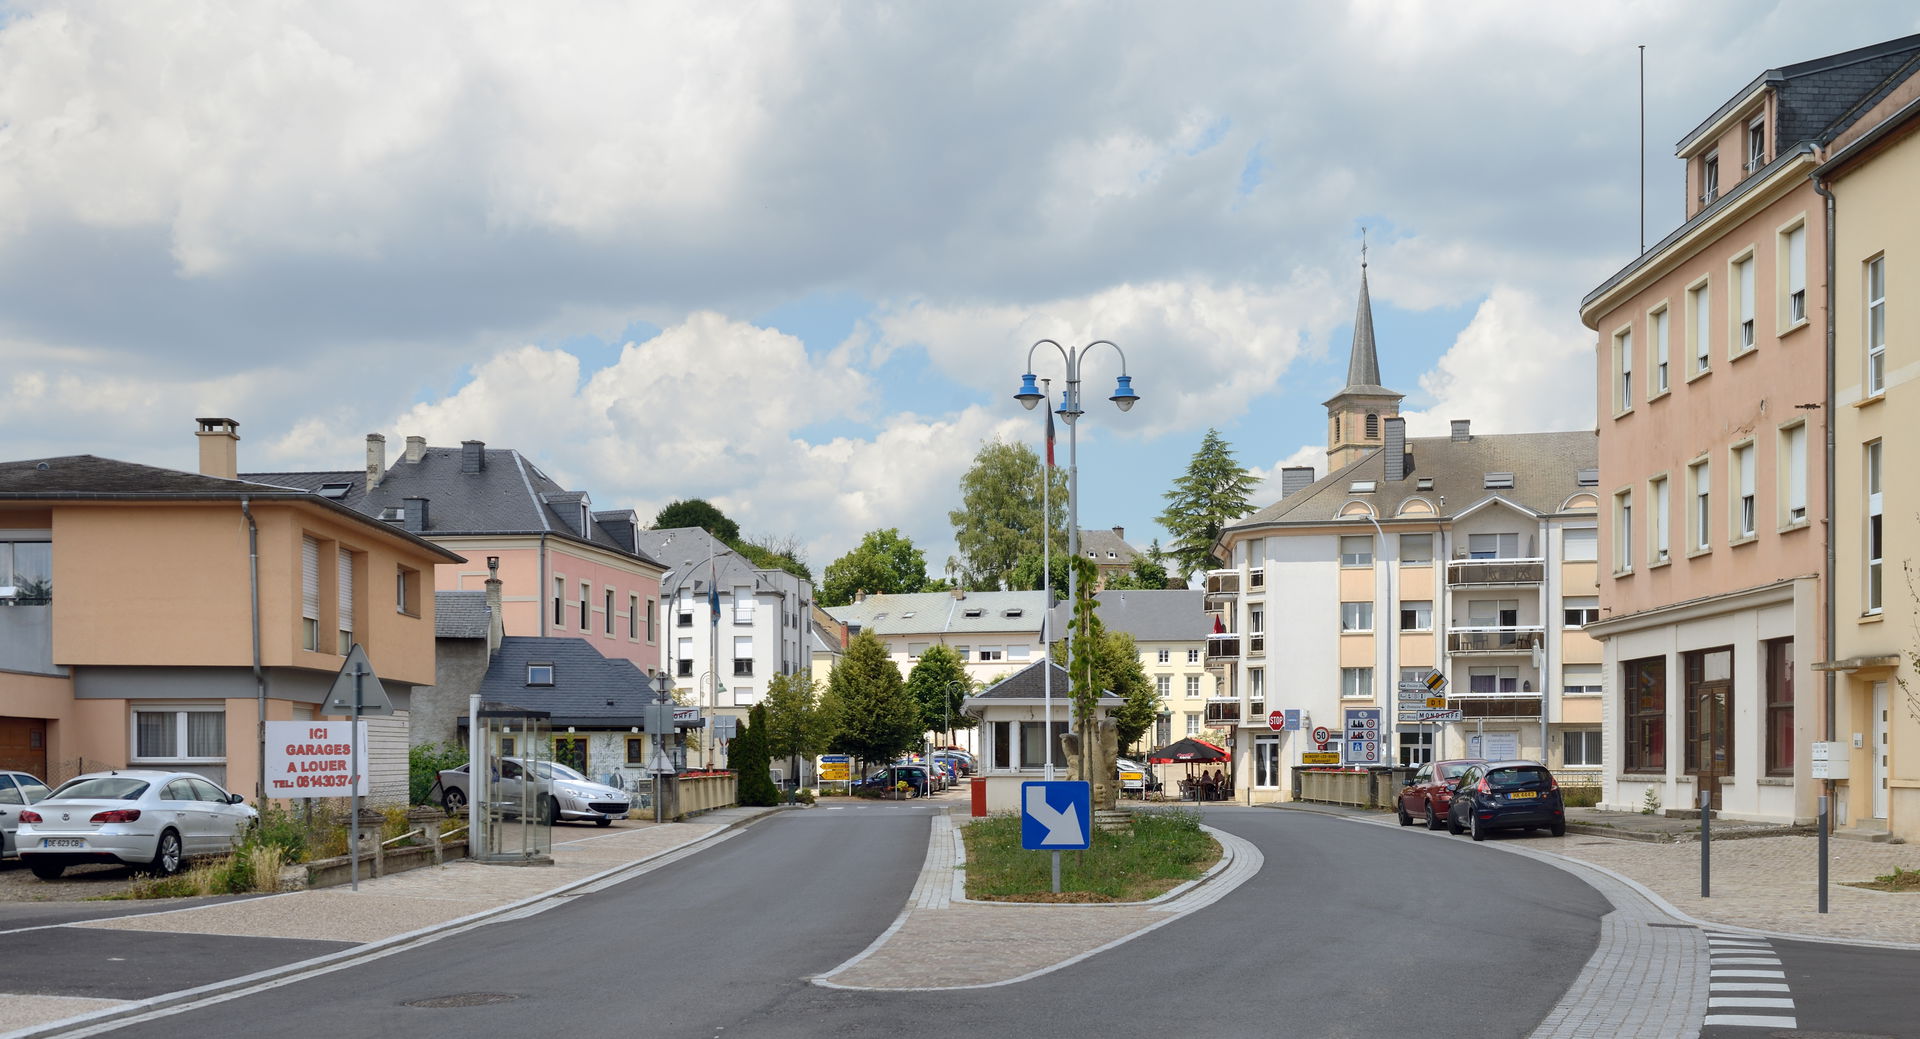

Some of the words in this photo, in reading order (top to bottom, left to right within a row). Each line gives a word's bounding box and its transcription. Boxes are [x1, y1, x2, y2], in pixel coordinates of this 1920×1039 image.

[1269, 716, 1283, 725] STOP
[1418, 712, 1460, 720] MONDORFF
[309, 728, 328, 739] ICI
[1316, 731, 1327, 740] 50
[285, 744, 351, 756] GARAGES
[287, 762, 297, 773] A
[300, 760, 347, 772] LOUER
[273, 780, 294, 788] TEL:
